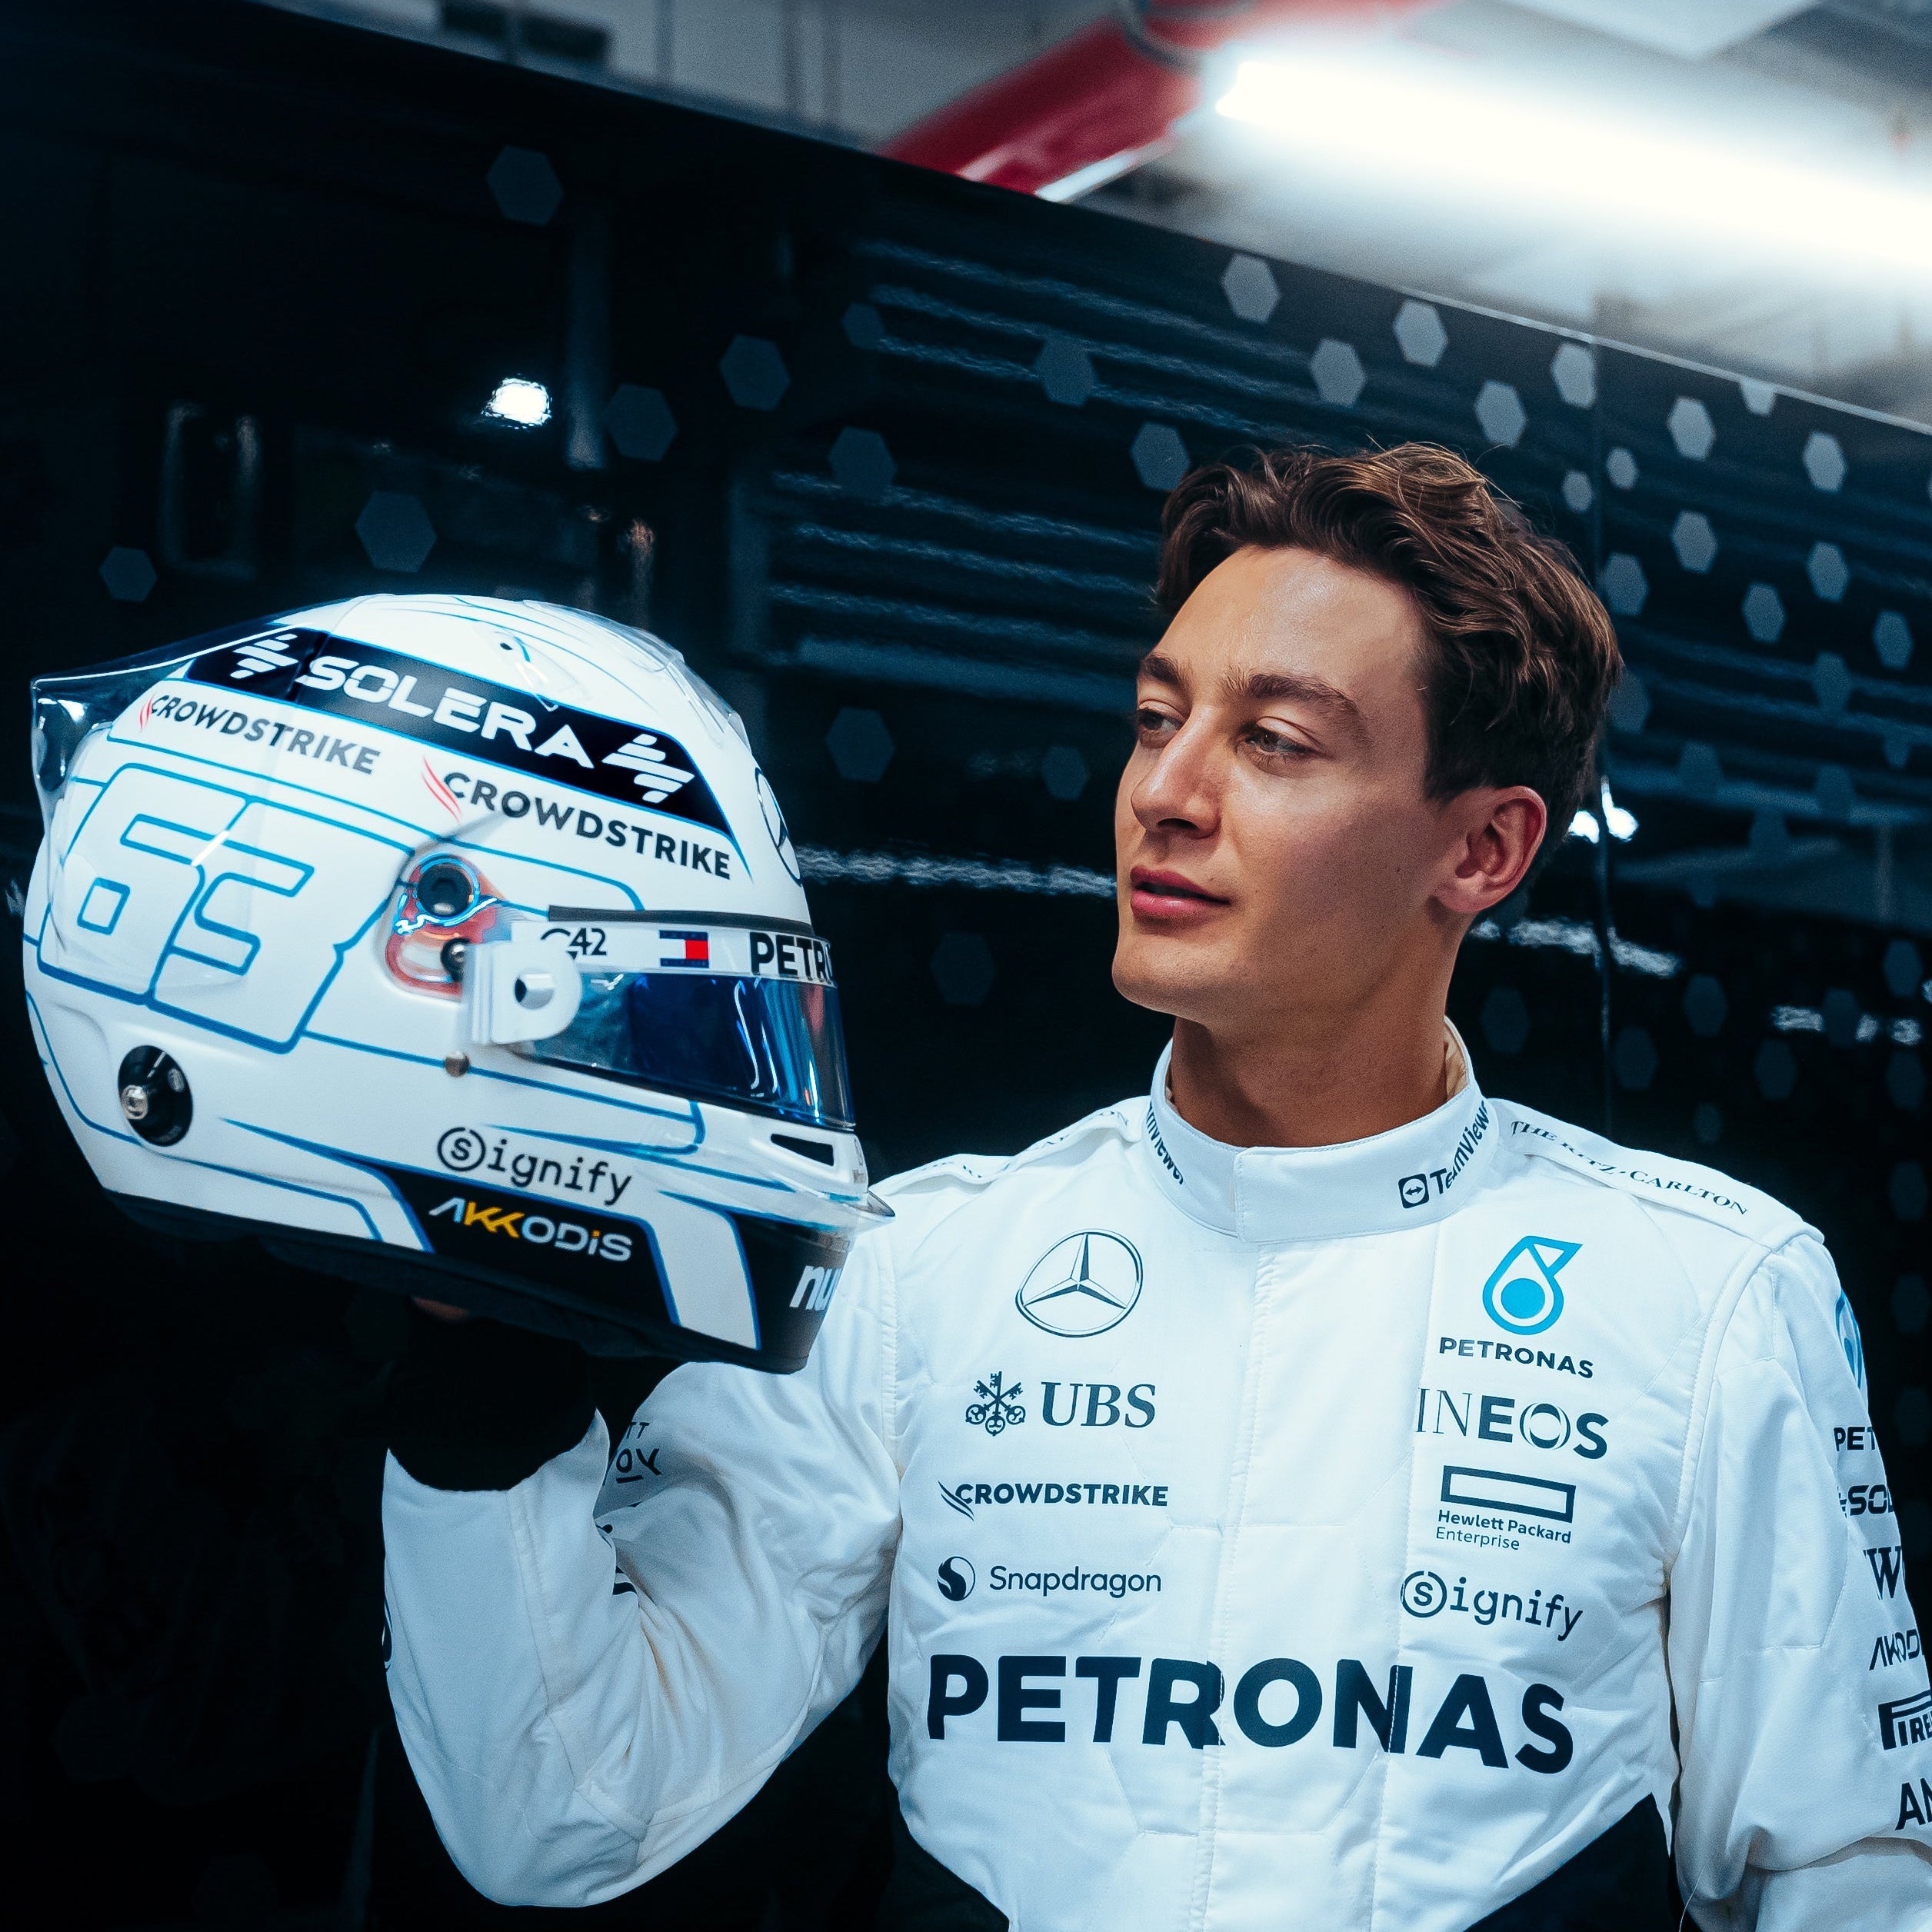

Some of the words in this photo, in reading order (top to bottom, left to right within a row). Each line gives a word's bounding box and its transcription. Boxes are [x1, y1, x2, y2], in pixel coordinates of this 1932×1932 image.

[150, 694, 381, 777] CROWDSTRIKE
[295, 654, 596, 769] SOLERA
[442, 771, 731, 881] CROWDSTRIKE
[37, 761, 415, 1054] 63
[540, 928, 608, 961] 42
[749, 931, 833, 984] PETR
[1146, 1100, 1184, 1185] mViewer
[1511, 1121, 1557, 1141] THE
[1561, 1142, 1748, 1215] Z-CARLTON
[1438, 1336, 1594, 1379] PETRONAS
[1041, 1381, 1157, 1429] UBS
[1415, 1387, 1610, 1460] INEOS
[954, 1481, 1170, 1509] CROWDSTRIKE
[1435, 1525, 1521, 1551] Enterprise
[1437, 1508, 1505, 1532] Hewlett
[1507, 1518, 1572, 1544] Packard
[989, 1565, 1162, 1599] Snapdragon
[926, 1654, 1574, 1774] PETRONAS
[1877, 1689, 1932, 1750] PIRE
